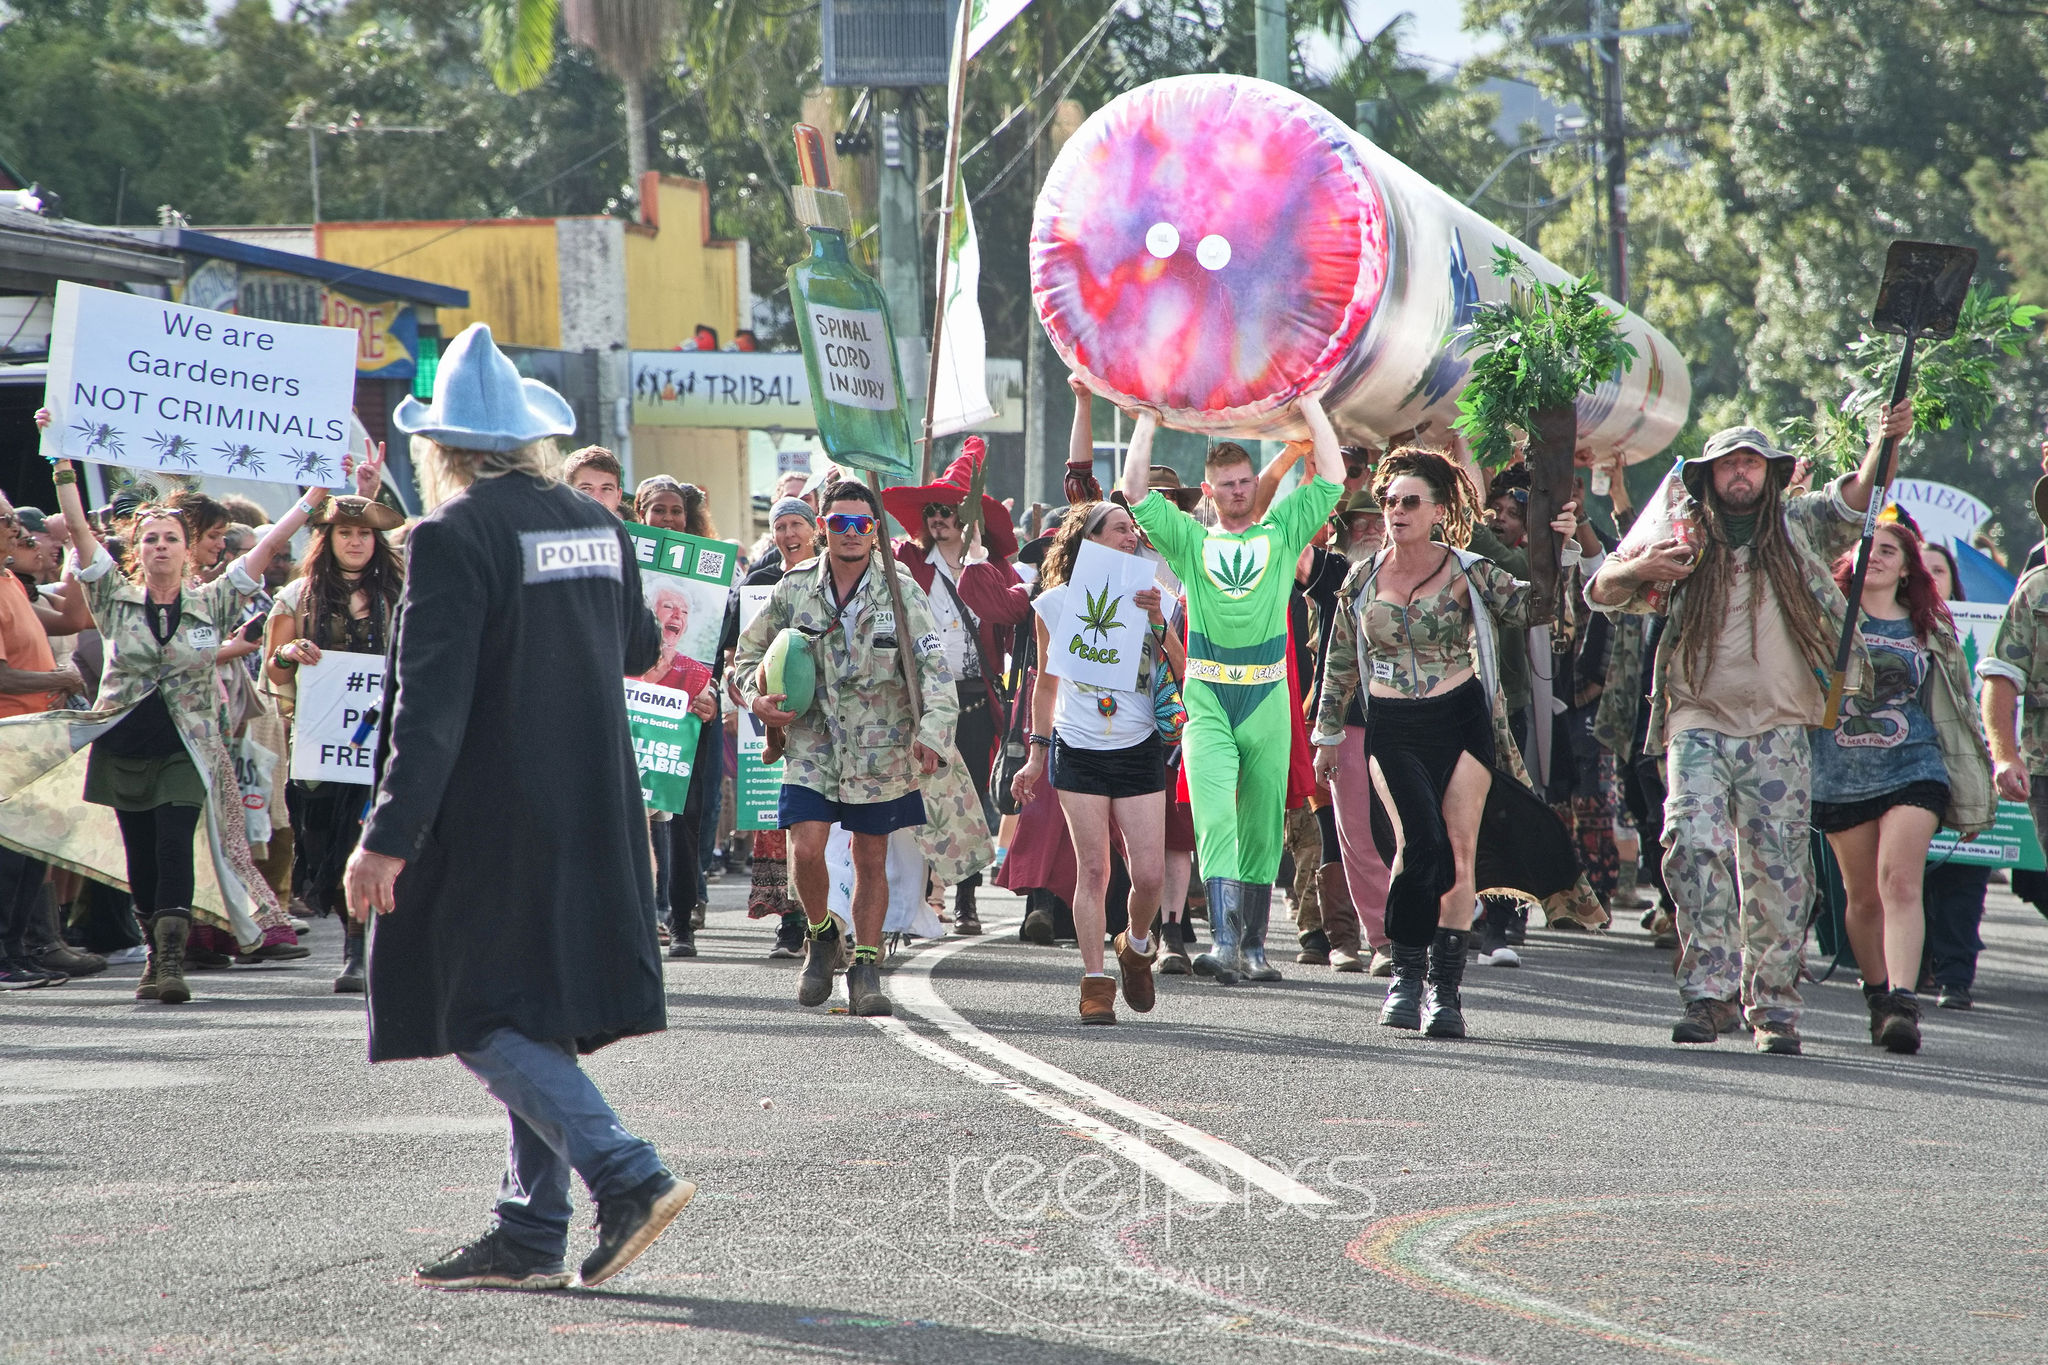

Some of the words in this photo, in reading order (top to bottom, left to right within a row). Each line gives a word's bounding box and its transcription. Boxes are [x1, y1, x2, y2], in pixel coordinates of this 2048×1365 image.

[163, 309, 213, 342] We
[222, 326, 275, 351] are
[815, 314, 872, 342] SPINAL
[825, 343, 871, 370] CORD
[128, 349, 301, 397] Gardeners
[829, 373, 885, 400] INJURY
[703, 374, 801, 406] TRIBAL
[74, 382, 149, 414] NOT
[158, 396, 345, 442] CRIMINALS
[1888, 482, 1987, 526] IMBIN
[541, 543, 617, 567] POLITE
[668, 544, 687, 570] 1
[633, 715, 650, 726] the
[649, 718, 680, 731] ballot
[320, 744, 376, 769] FRE
[632, 737, 683, 761] LISE
[744, 742, 766, 750] LEG
